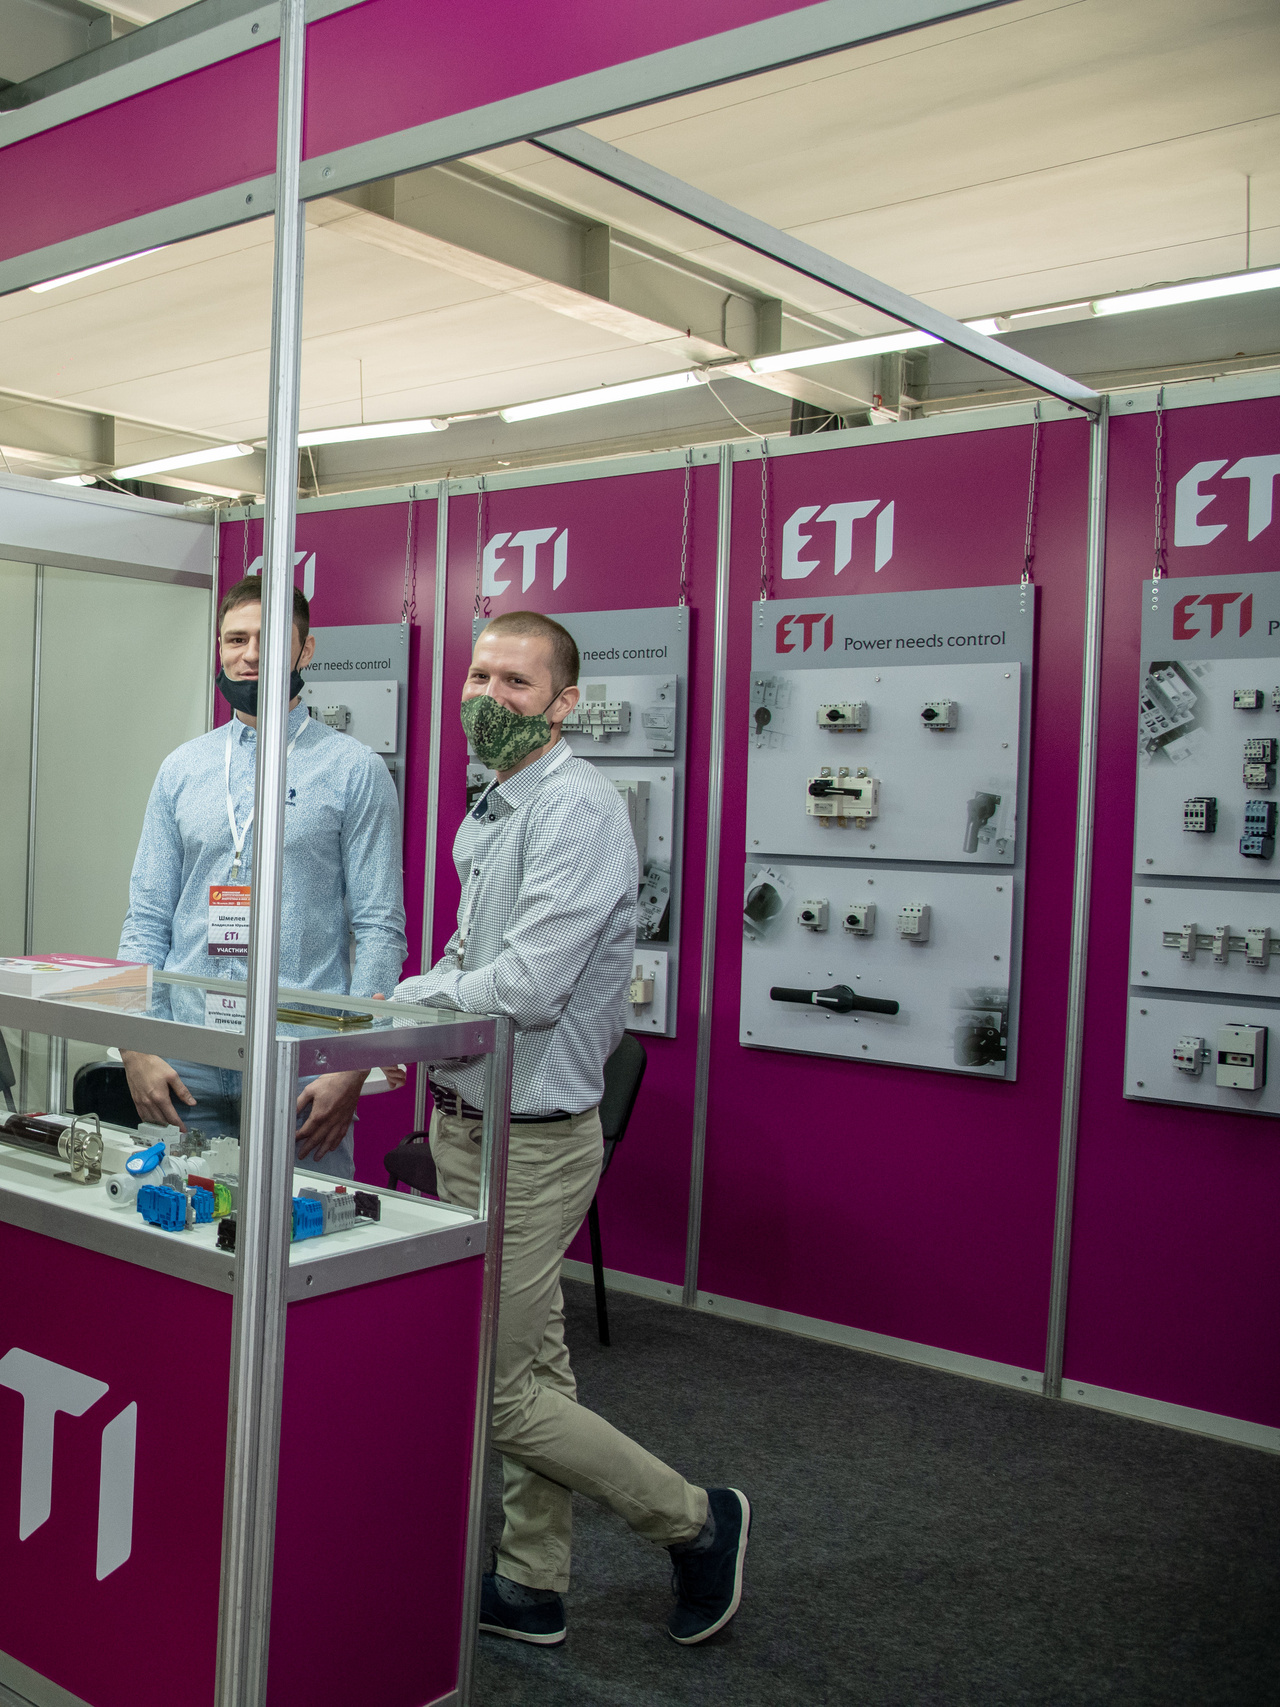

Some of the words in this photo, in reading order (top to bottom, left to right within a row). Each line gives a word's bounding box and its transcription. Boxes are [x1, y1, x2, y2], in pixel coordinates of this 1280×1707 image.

[1173, 453, 1280, 548] ET
[781, 499, 895, 580] ETI
[481, 527, 569, 598] ETI
[775, 613, 834, 654] ETI
[1173, 592, 1253, 641] ETI
[583, 647, 620, 660] needs
[622, 645, 668, 659] control
[844, 637, 893, 651] Power
[895, 634, 944, 649] needs
[947, 631, 1007, 648] control
[301, 661, 322, 671] wer
[323, 659, 354, 671] needs
[355, 658, 391, 669] control
[224, 931, 239, 941] ETI
